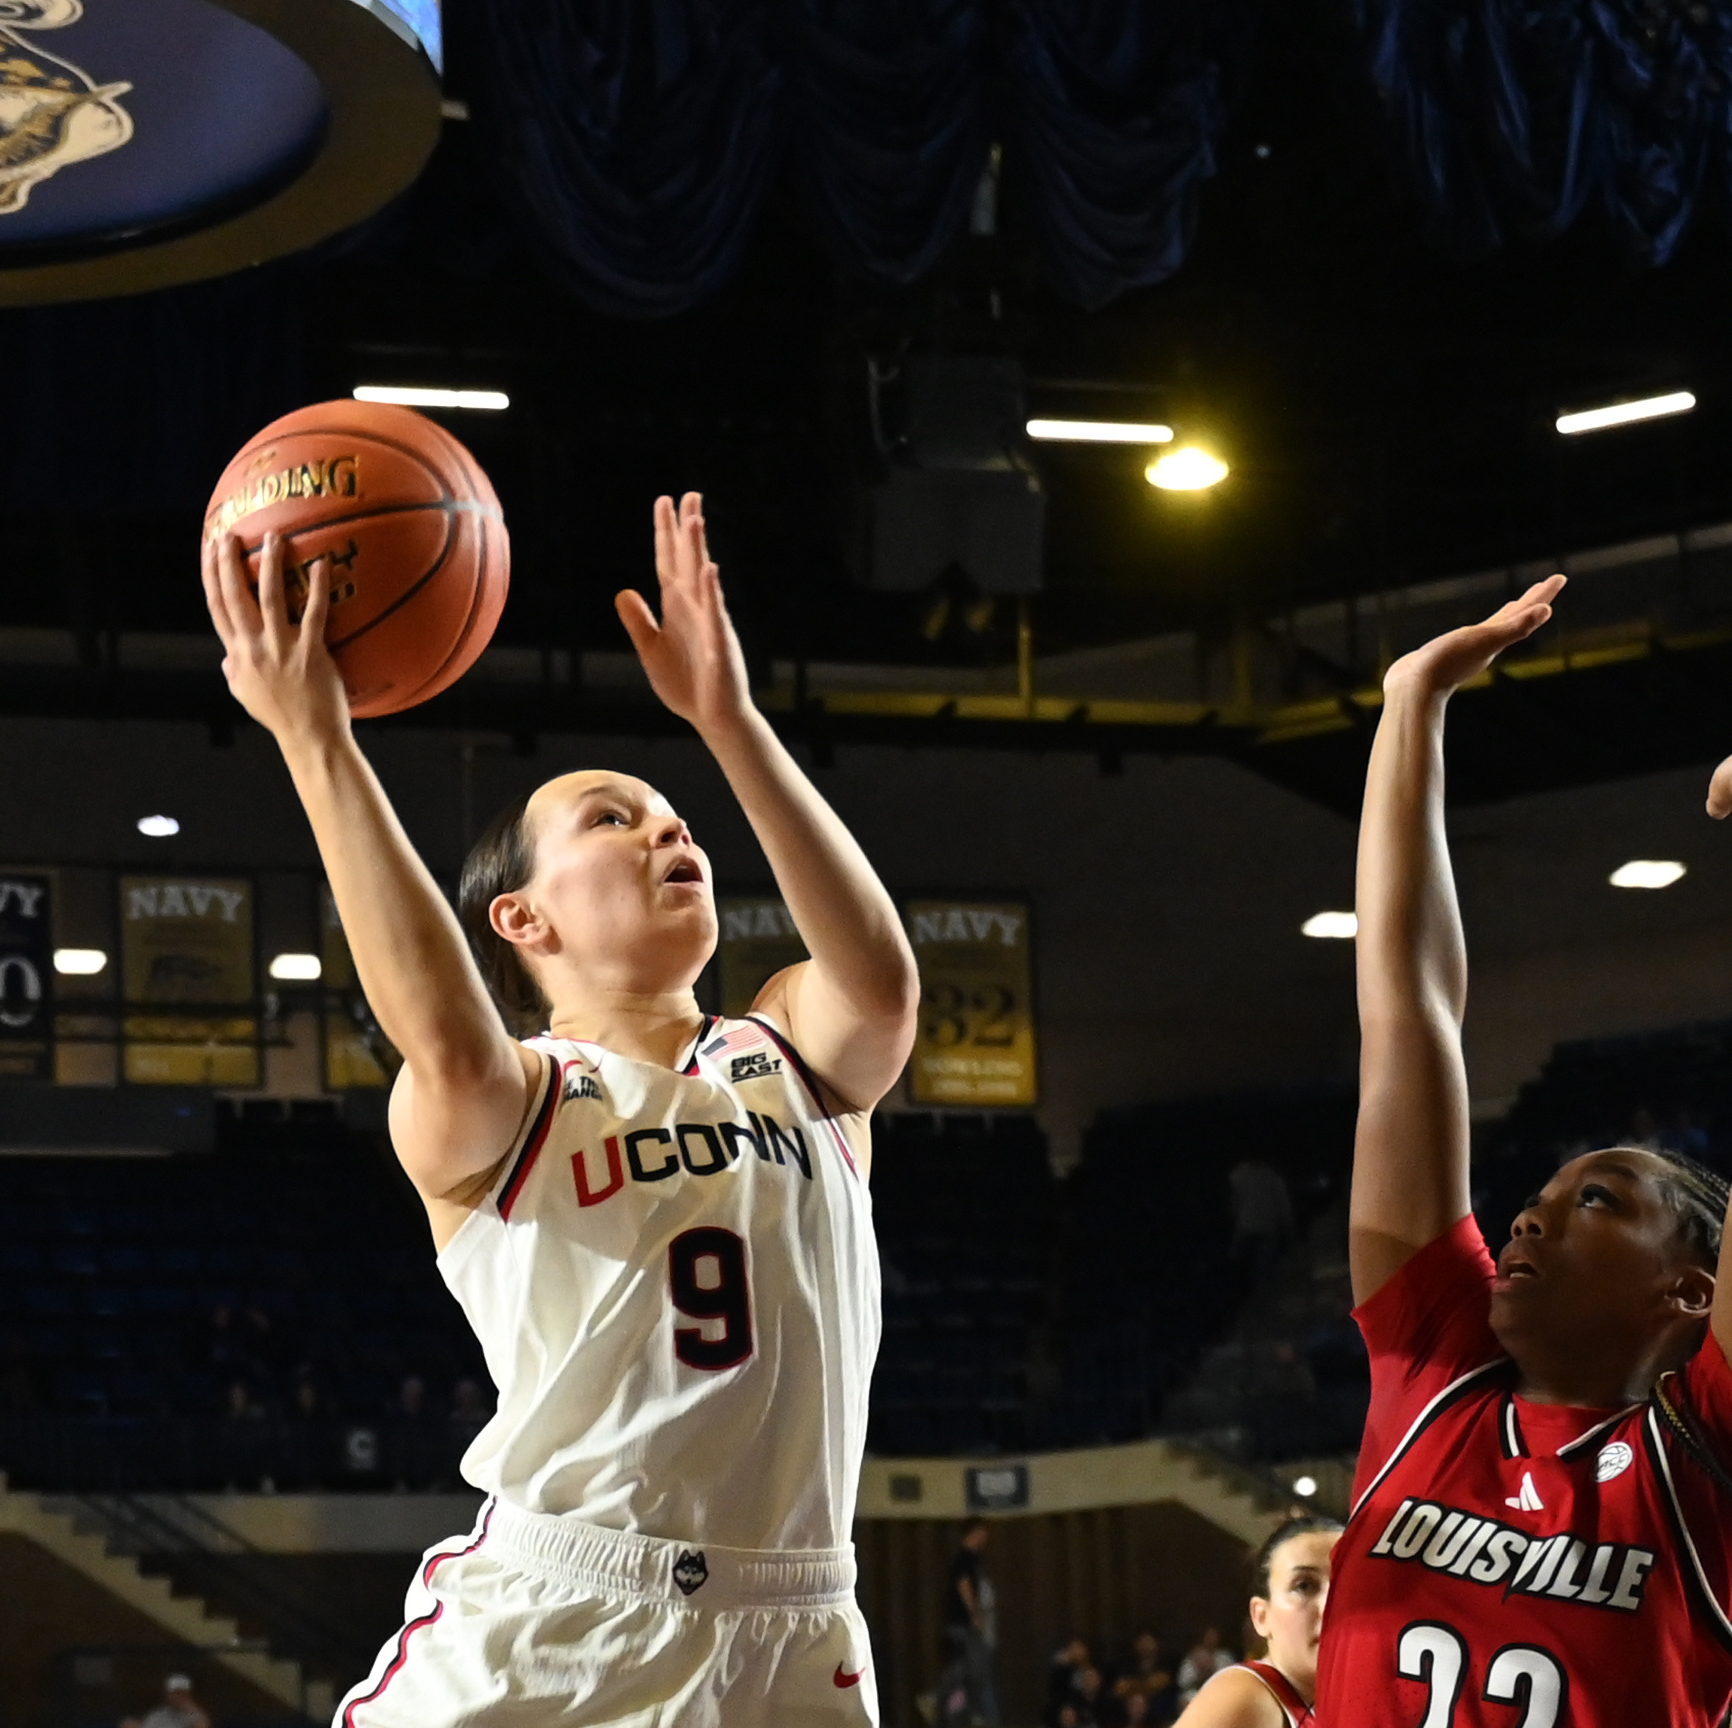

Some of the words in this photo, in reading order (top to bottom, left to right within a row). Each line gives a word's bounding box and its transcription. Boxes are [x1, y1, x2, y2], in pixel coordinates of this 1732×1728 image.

[126, 887, 243, 923] NAVY
[724, 903, 798, 942] NA
[912, 909, 1022, 948] NAVY
[731, 1052, 767, 1068] BIG
[731, 1059, 782, 1078] EAST
[571, 1109, 813, 1208] UCONN
[668, 1226, 753, 1371] 9
[1370, 1496, 1656, 1612] LOUISVILLE
